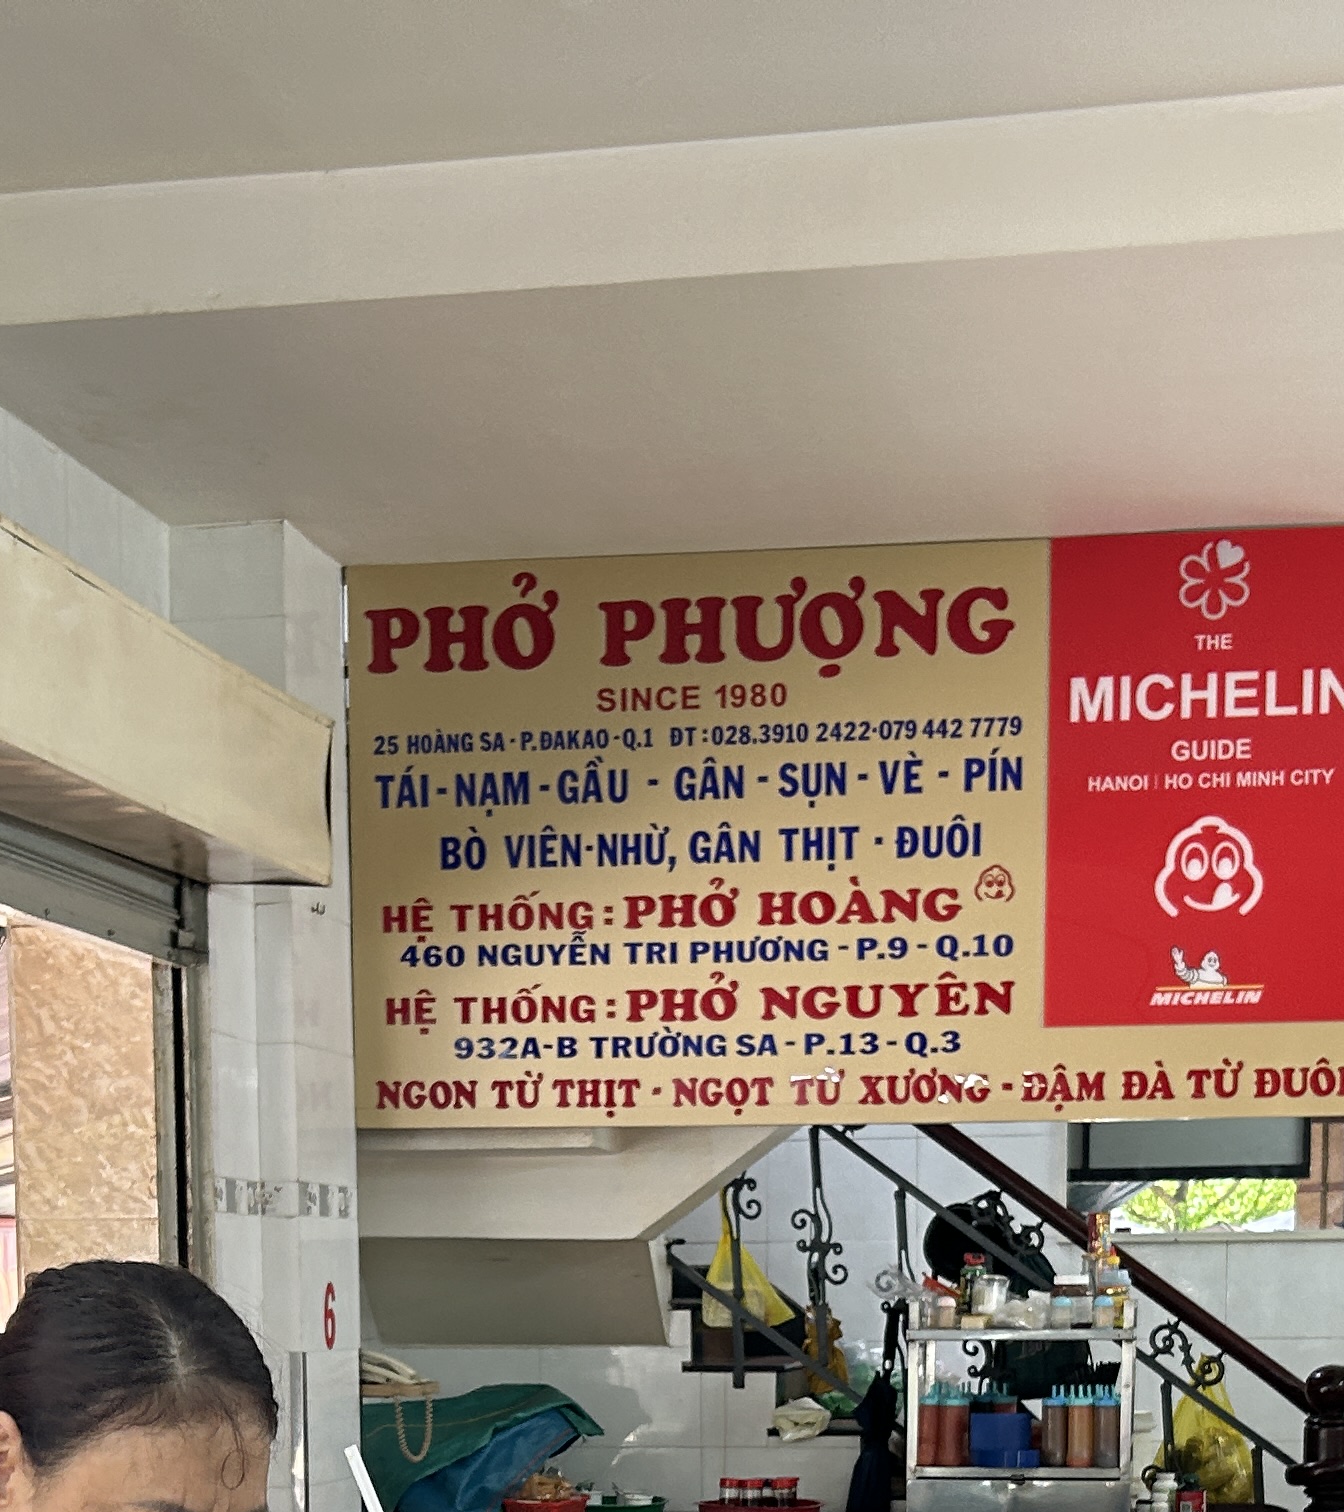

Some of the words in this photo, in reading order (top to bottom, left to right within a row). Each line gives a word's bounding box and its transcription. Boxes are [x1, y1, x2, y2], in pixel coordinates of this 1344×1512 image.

[365, 572, 558, 674] PHỞ
[598, 575, 1014, 679] PHƯỢNG
[1194, 633, 1233, 651] THE
[596, 686, 701, 712] SINCE
[714, 683, 788, 709] 1980
[373, 735, 399, 755] 25
[407, 729, 474, 755] HOÀNG
[480, 733, 505, 753] SA
[922, 718, 963, 740] 442
[969, 716, 1023, 738] 7779
[1170, 737, 1253, 762] GUIDE
[674, 756, 745, 801] GÂN
[778, 762, 847, 808] SỤN
[878, 750, 924, 795] VÈ
[963, 746, 1023, 792] PÍN
[1087, 774, 1150, 793] HANOI
[1164, 772, 1194, 790] HO
[1198, 771, 1232, 790] CHI
[1236, 769, 1286, 788] MINH
[1290, 766, 1336, 786] CITY
[439, 826, 488, 870] BÒ
[687, 821, 762, 864] GÂN
[778, 826, 861, 871] THỊT
[895, 814, 982, 860] ĐUÔI
[382, 898, 435, 943] HỆ
[622, 877, 740, 929] PHỞ
[757, 875, 963, 925] HOÀNG
[400, 945, 466, 968] 460
[476, 930, 612, 967] NGUYỄN
[622, 941, 678, 966] TRI
[688, 936, 830, 964] PHƯƠNG
[856, 937, 909, 961] P.9
[935, 934, 1015, 962] Q.10
[386, 989, 438, 1035] HỆ
[625, 971, 740, 1023] PHỞ
[759, 971, 1016, 1020] NGUYÊN
[1149, 989, 1263, 1006] MICHELIN
[454, 1036, 579, 1059] 932A-B
[589, 1026, 728, 1059] TRƯỜNG
[735, 1033, 779, 1056] SA
[803, 1032, 880, 1056] P.13
[905, 1030, 962, 1058] Q.3
[376, 1080, 479, 1110] NGON
[490, 1070, 545, 1109] TỪ
[552, 1079, 642, 1118] THỊT
[672, 1076, 774, 1116] NGỌT
[857, 1067, 992, 1106] XƯƠNG
[1020, 1062, 1106, 1112] ĐẬM
[1121, 1059, 1176, 1101] ĐÀ
[1185, 1057, 1245, 1099] TỪ
[324, 1281, 336, 1350] 6
